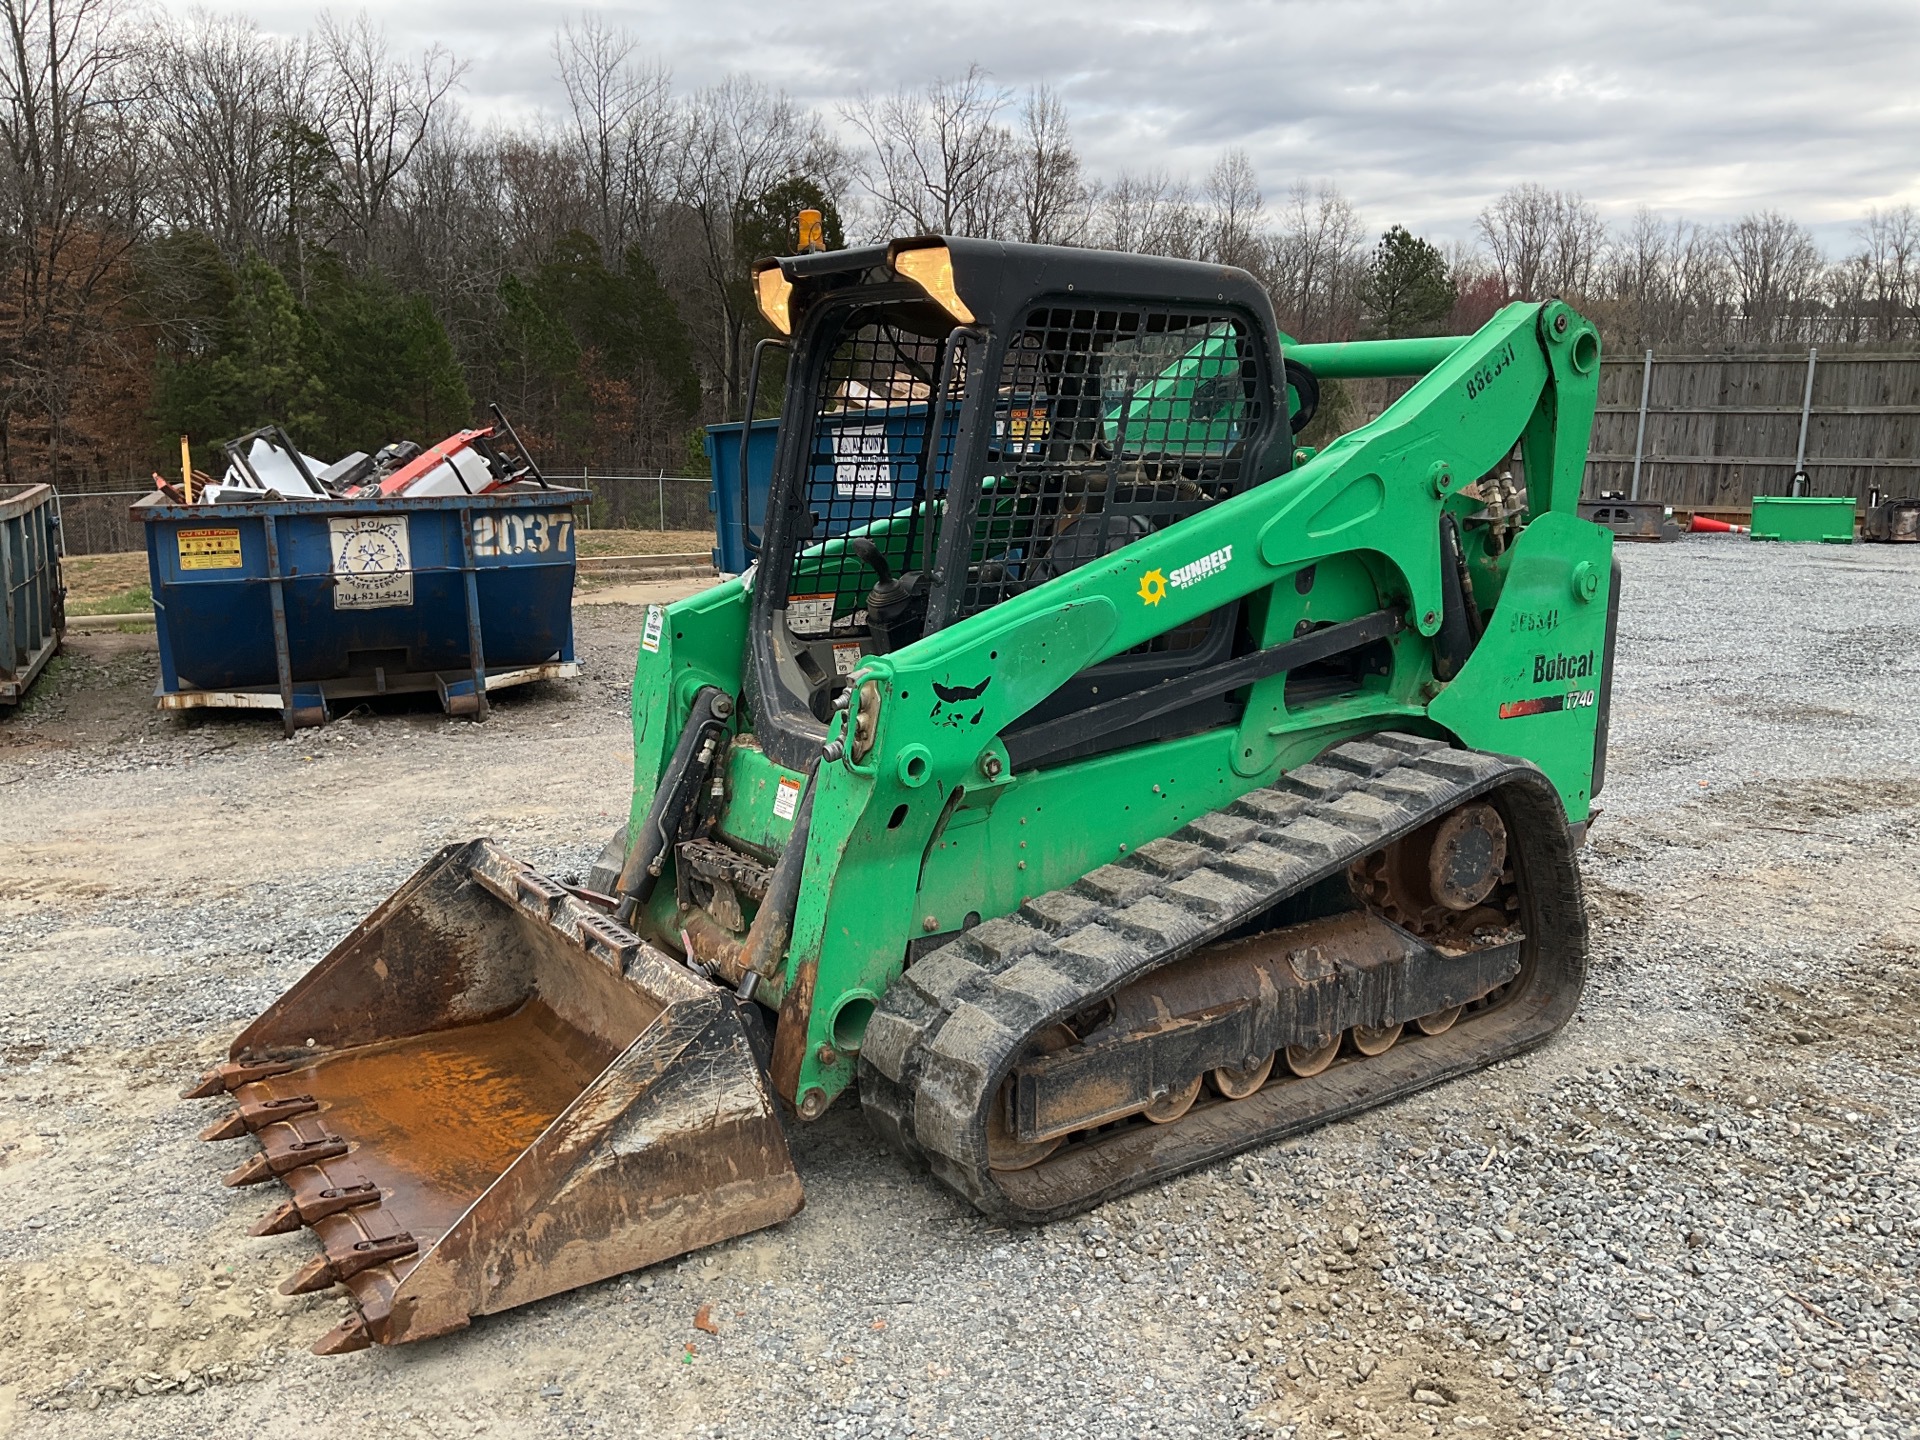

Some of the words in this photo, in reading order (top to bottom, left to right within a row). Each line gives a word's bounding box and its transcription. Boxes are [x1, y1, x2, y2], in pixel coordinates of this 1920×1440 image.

[361, 520, 398, 537] POINTS
[473, 513, 573, 556] 2037
[1169, 544, 1233, 588] SUNBELT
[1181, 563, 1228, 590] RENTALS
[344, 574, 371, 590] WASTE
[339, 590, 410, 603] 704-821-5424
[1533, 649, 1595, 684] Bobcat
[1566, 690, 1596, 710] T740
